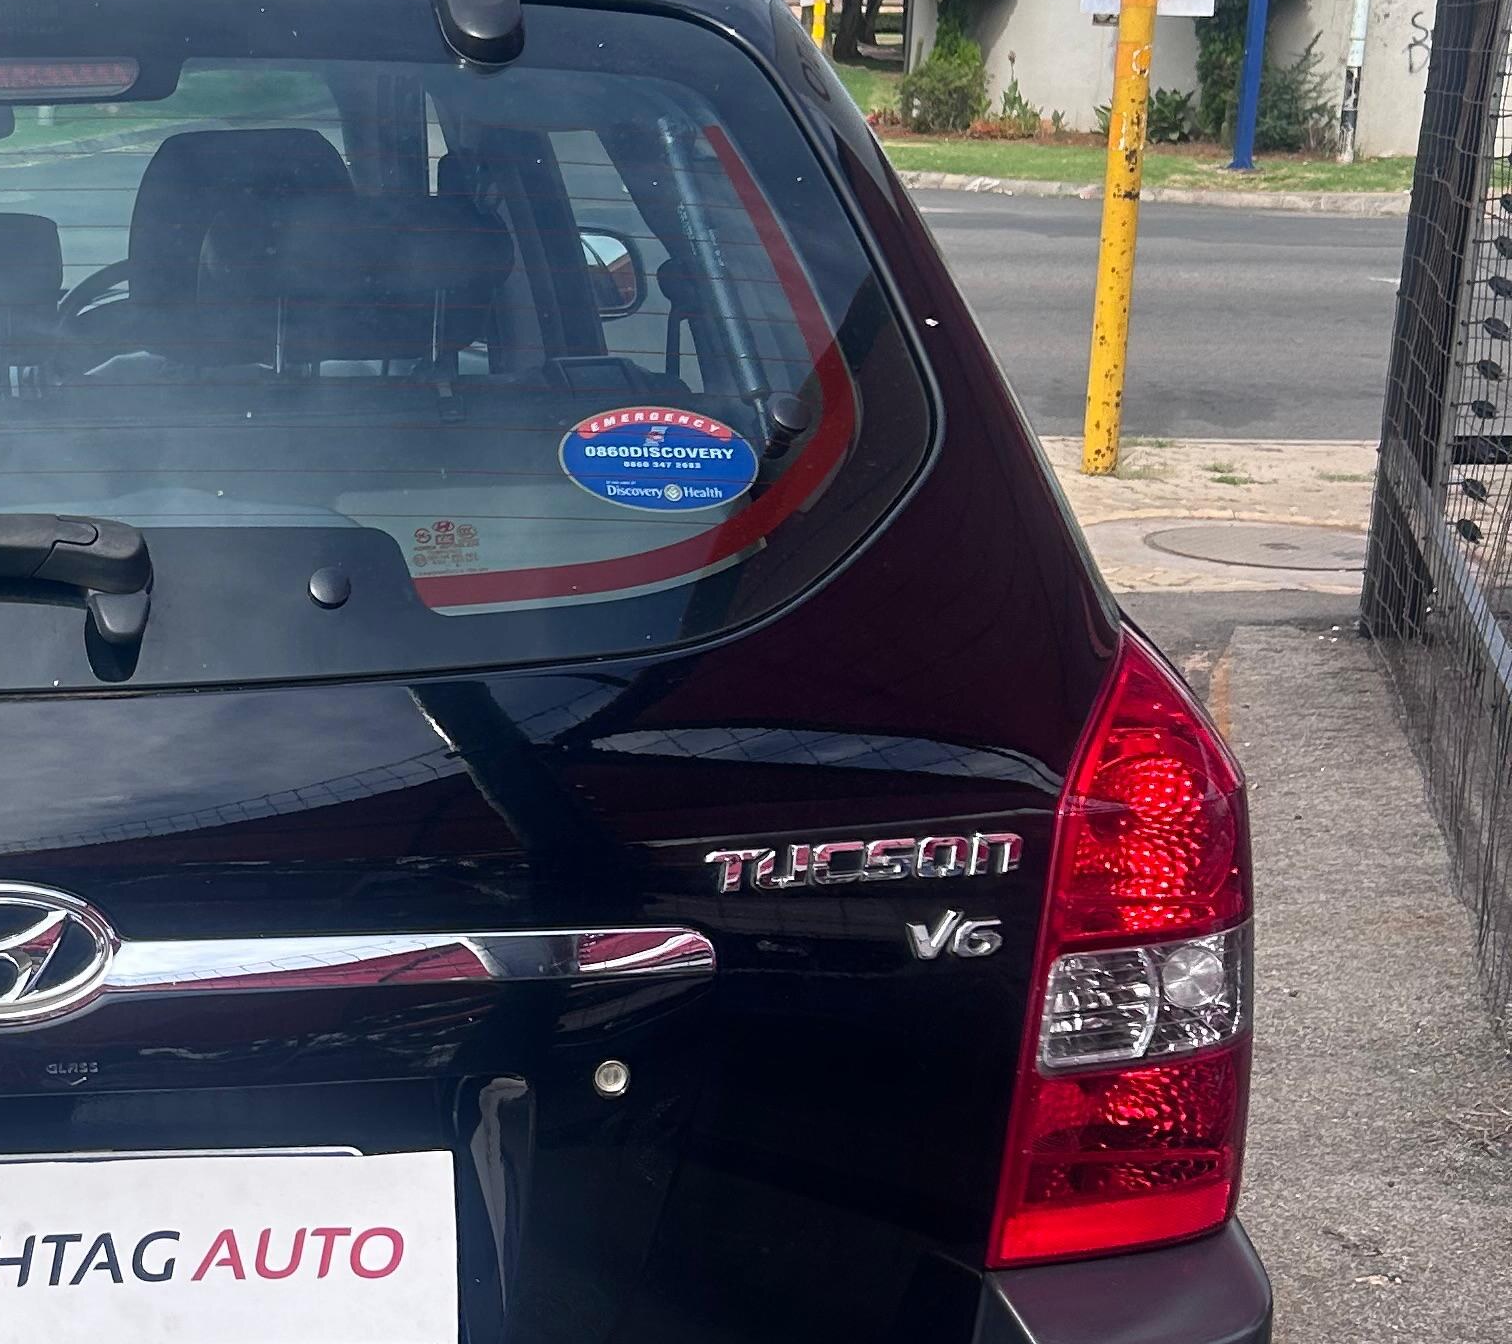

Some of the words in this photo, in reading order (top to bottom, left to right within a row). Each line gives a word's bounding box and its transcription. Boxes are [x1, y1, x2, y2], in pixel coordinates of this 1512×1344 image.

[590, 412, 720, 433] EMERGENCY
[584, 446, 734, 460] 0860DISCOVERY
[607, 485, 663, 499] Discovery
[682, 487, 723, 498] Health
[704, 832, 1024, 894] TUCSON
[904, 908, 1003, 961] V6
[46, 1062, 99, 1075] GLASS
[191, 1226, 407, 1283] AUTO
